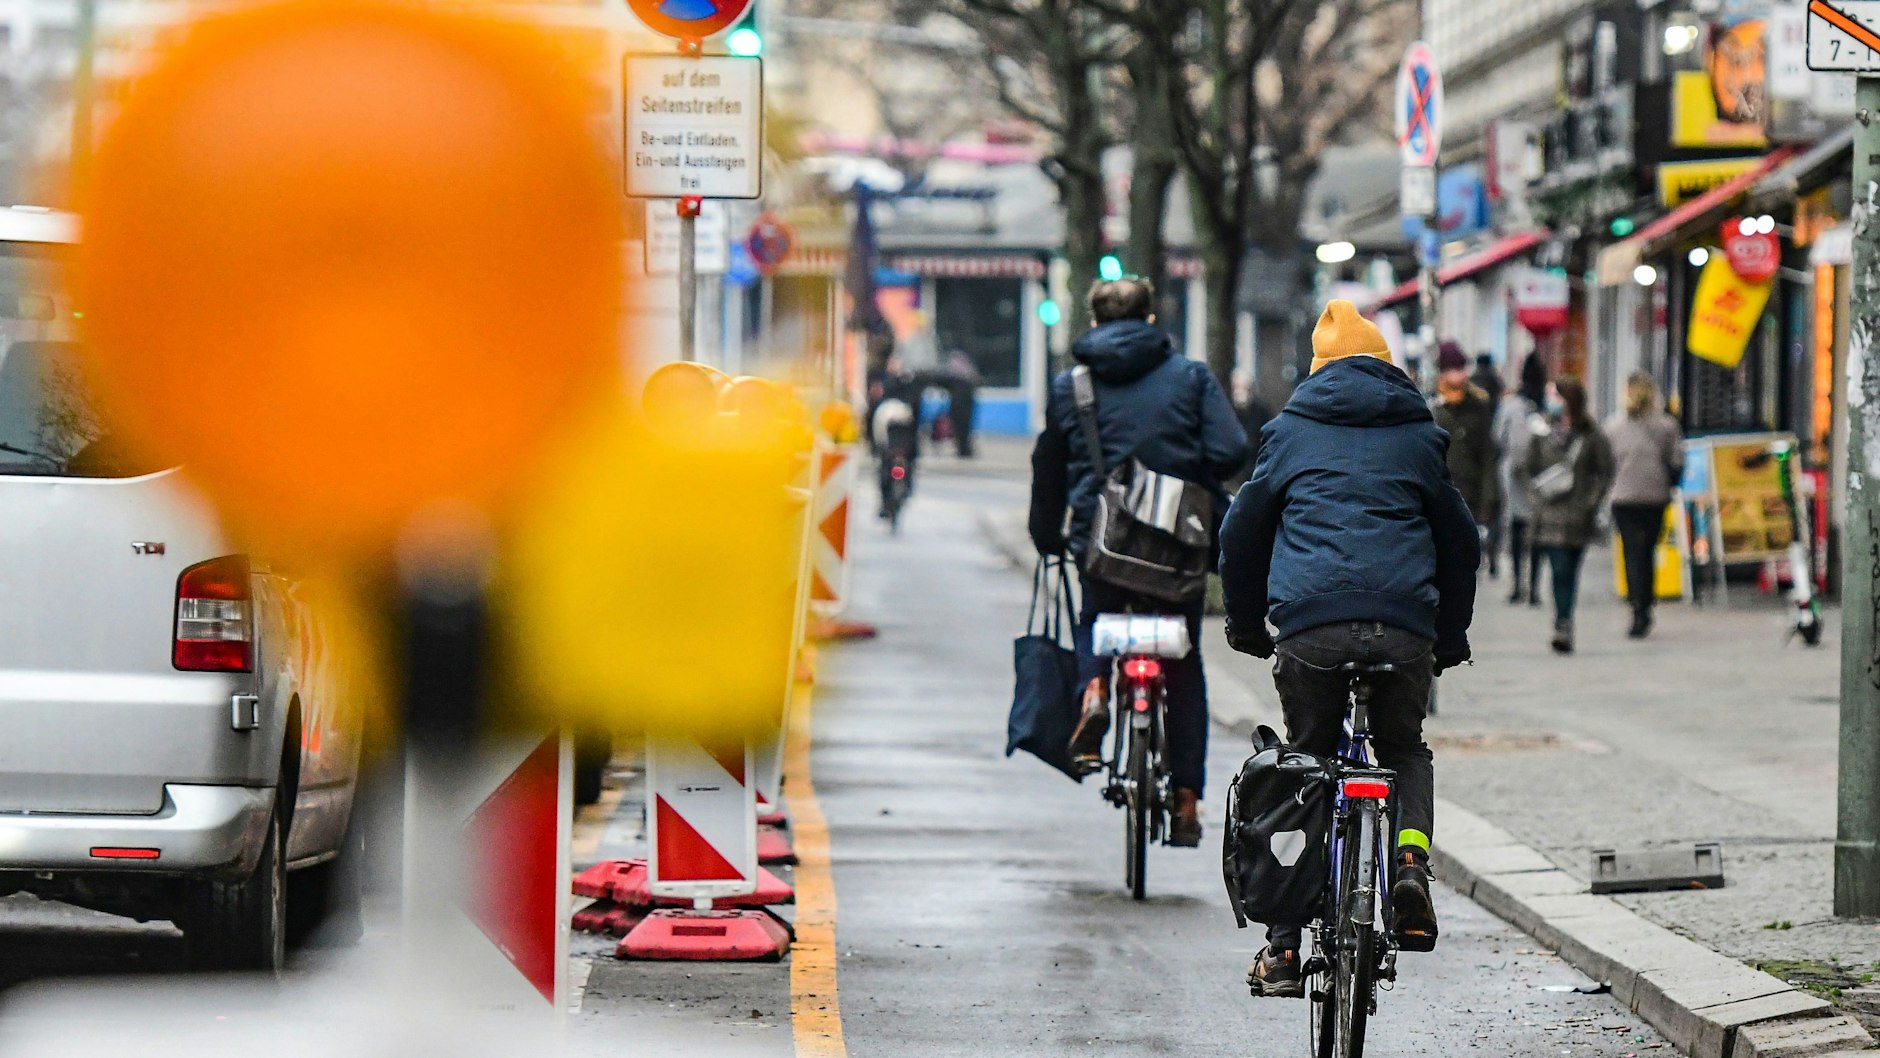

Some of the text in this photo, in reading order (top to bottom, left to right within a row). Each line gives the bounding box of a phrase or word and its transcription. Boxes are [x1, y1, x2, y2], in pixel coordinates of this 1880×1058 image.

[1830, 39, 1841, 61] 7
[662, 70, 721, 88] auf dem
[641, 96, 742, 114] Seitenstreifen
[684, 152, 746, 171] Aussteigen
[680, 174, 701, 188] frei
[132, 541, 165, 555] TDI
